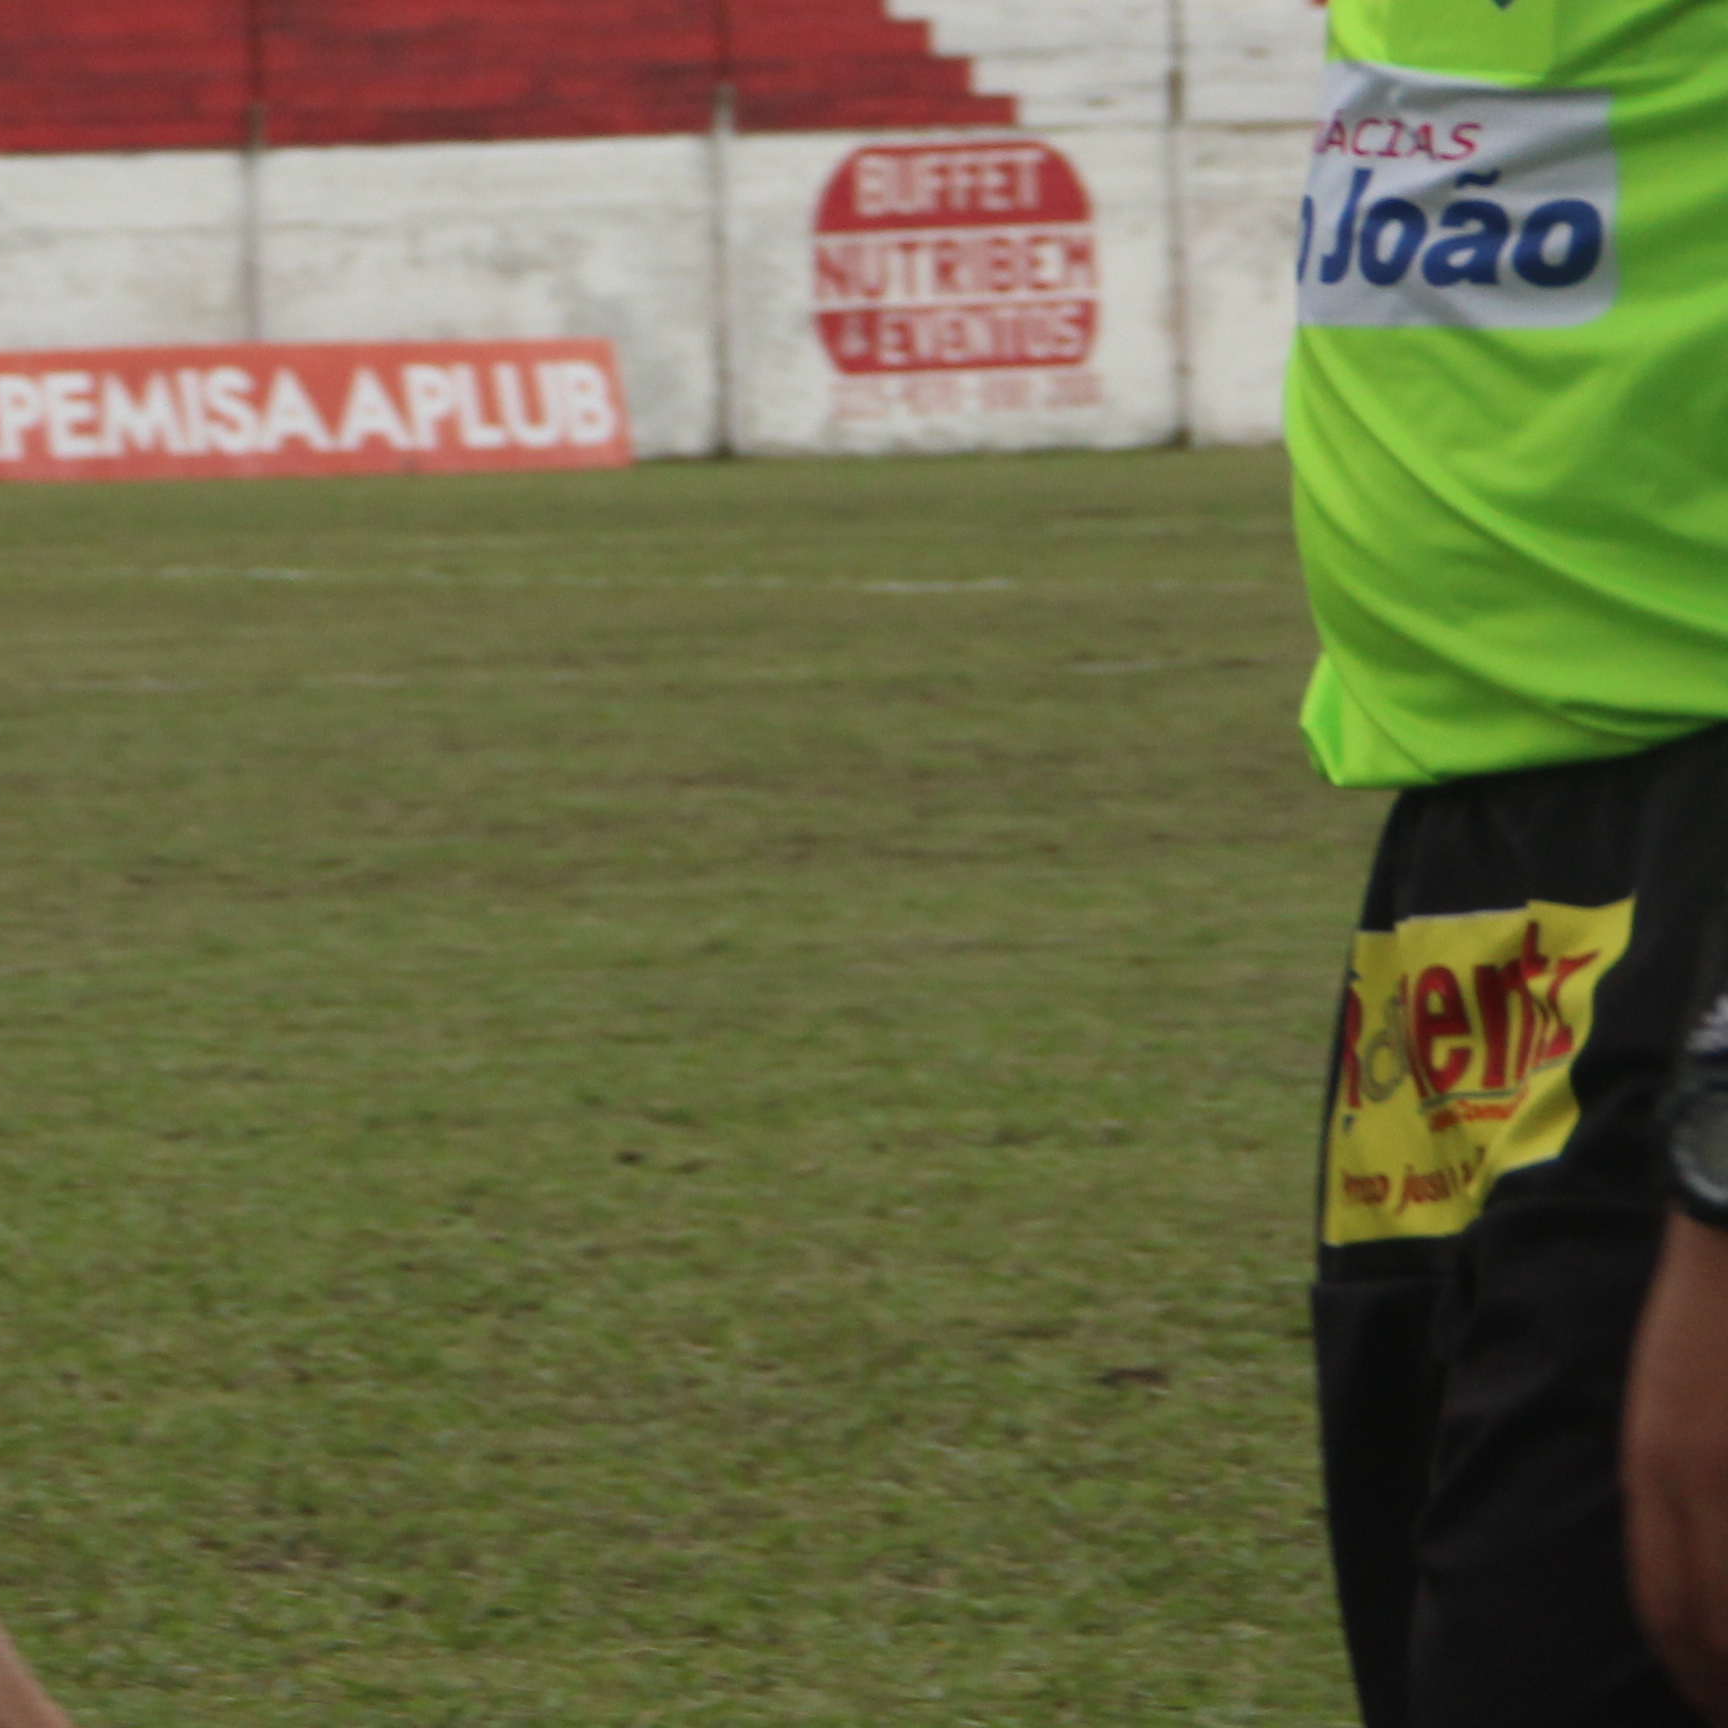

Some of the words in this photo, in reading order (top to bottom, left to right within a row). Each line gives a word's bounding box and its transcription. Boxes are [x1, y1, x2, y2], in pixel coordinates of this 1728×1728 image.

[1315, 110, 1484, 161] ÁCIAS
[854, 149, 1043, 218] BUFFET
[1319, 166, 1605, 290] João
[878, 303, 1086, 367] EVENTOS
[343, 358, 619, 454] APLUB
